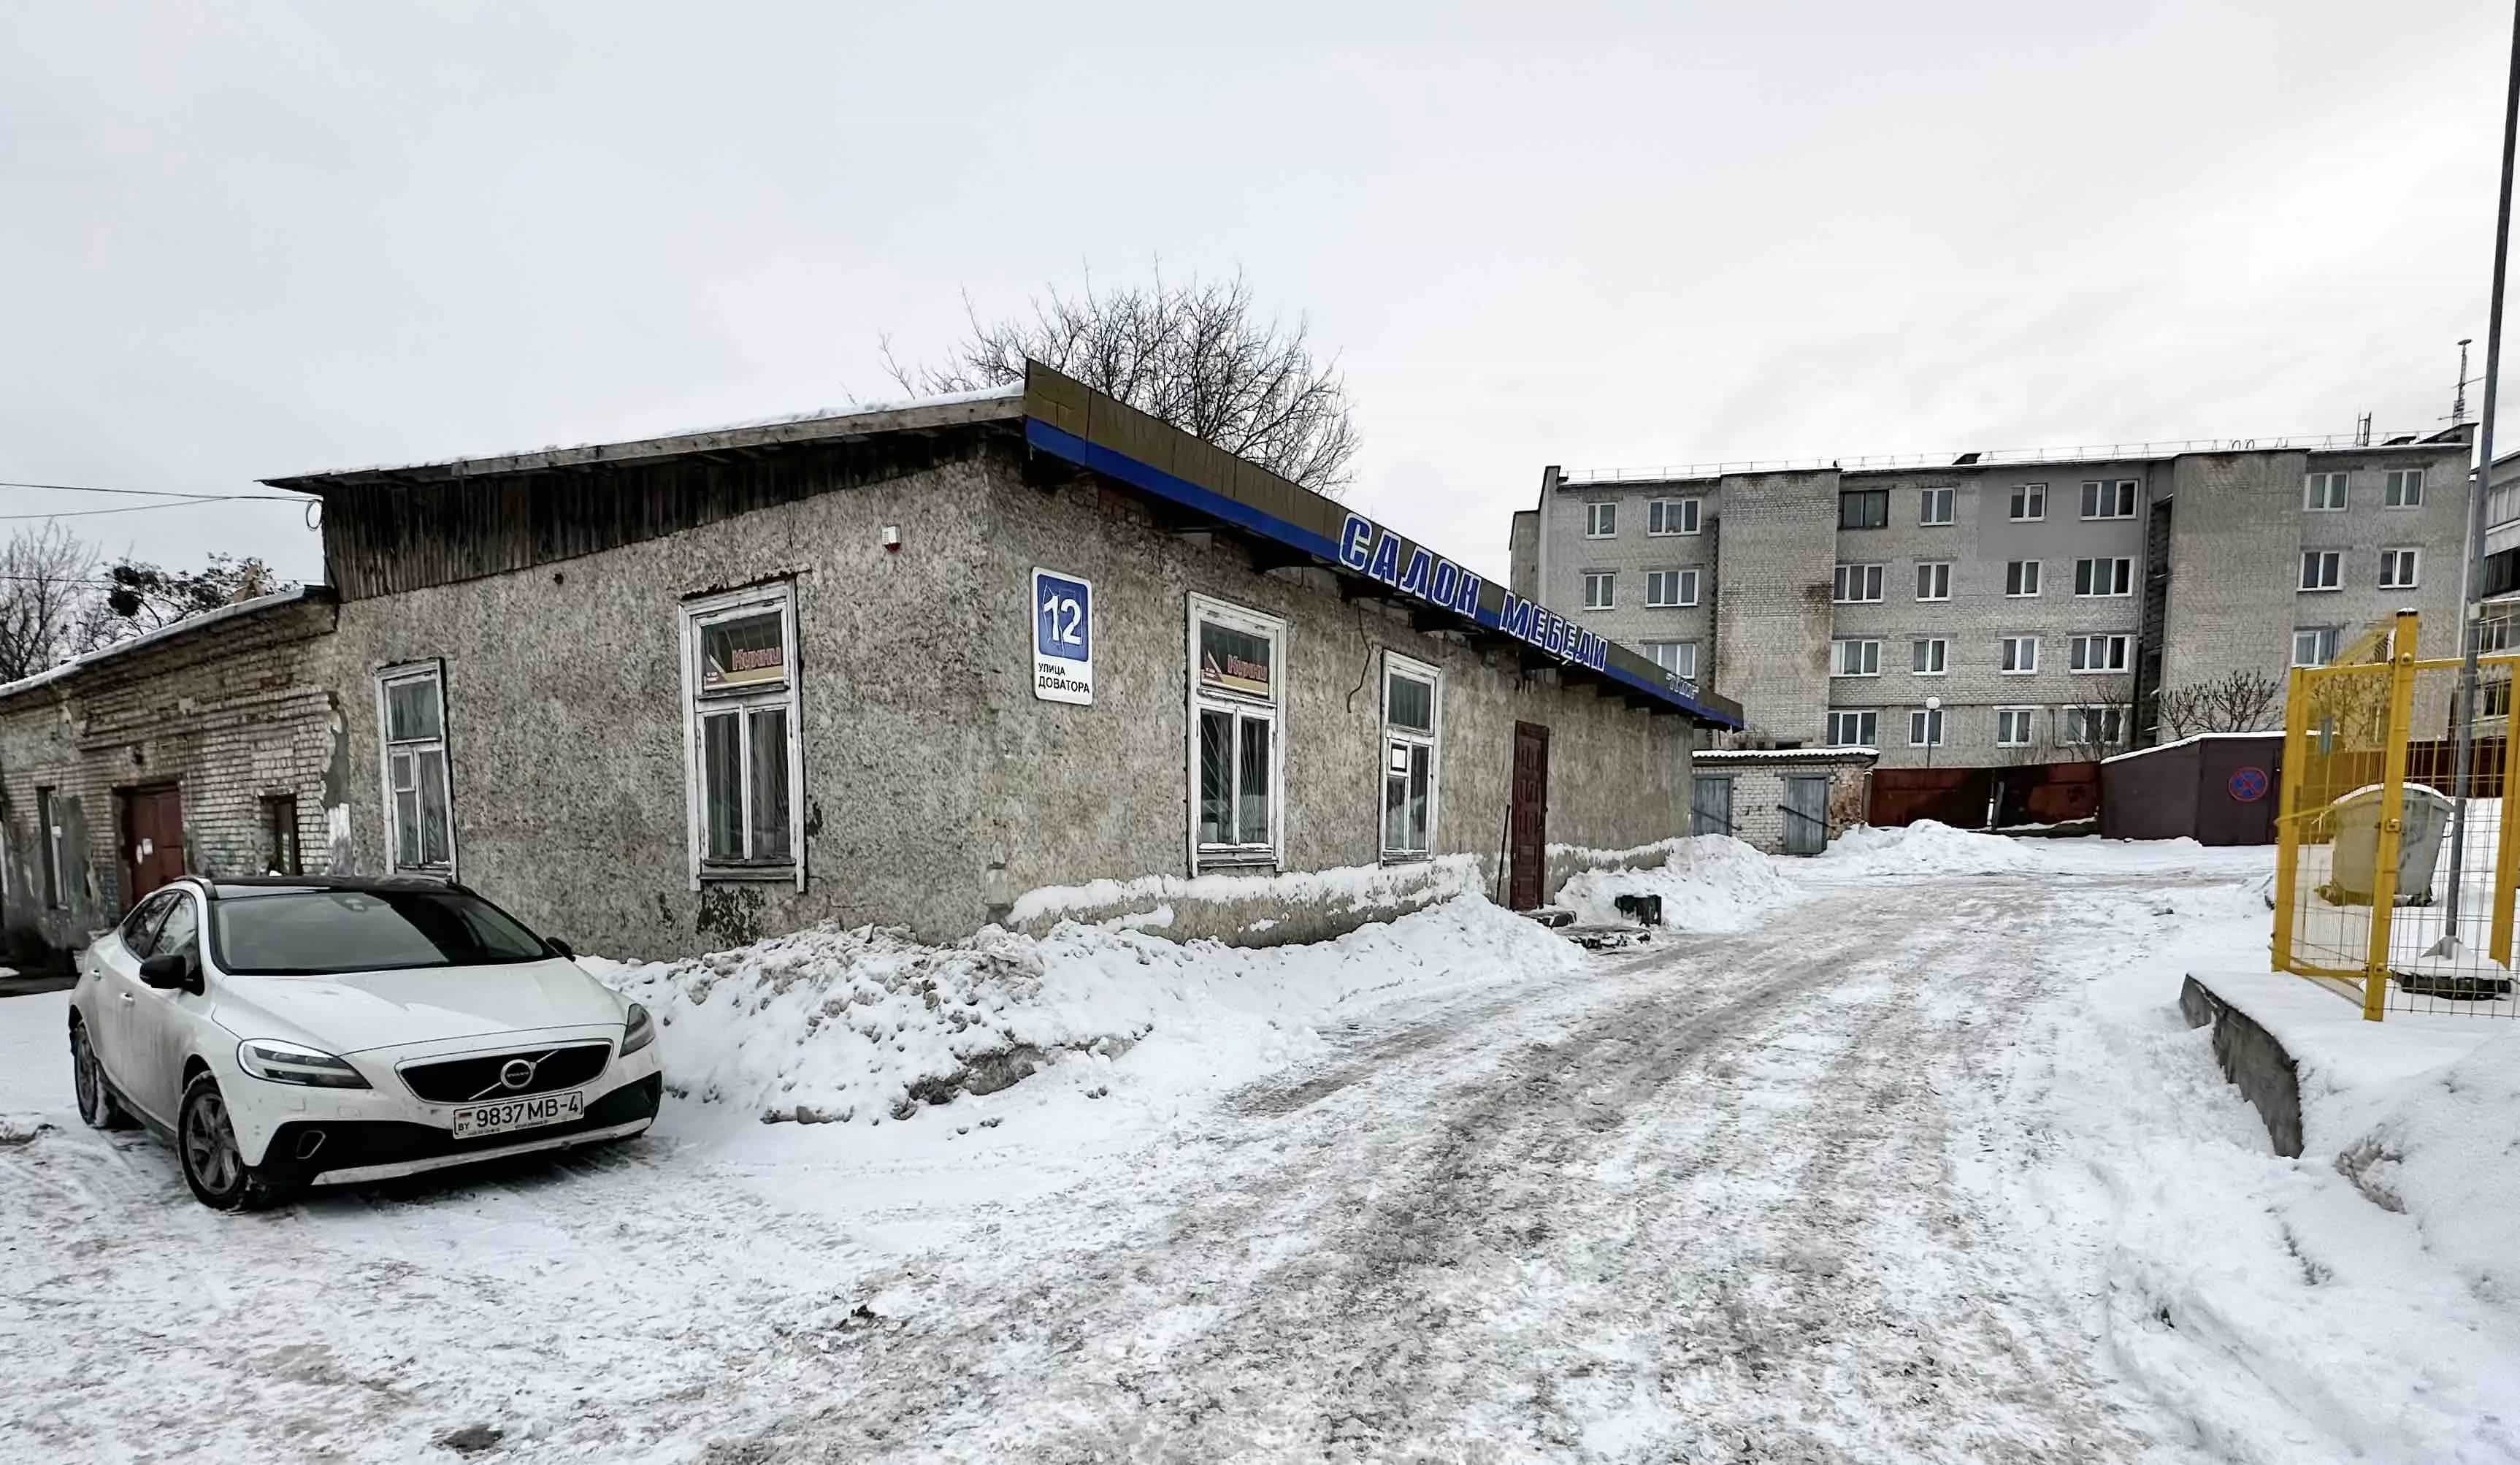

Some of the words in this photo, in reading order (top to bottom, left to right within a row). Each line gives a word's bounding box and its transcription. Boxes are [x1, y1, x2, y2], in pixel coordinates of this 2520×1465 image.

[1337, 510, 1482, 619] САЛОН
[1498, 590, 1609, 672] МЕБЕЛИ
[1043, 595, 1081, 646] 12
[1038, 662, 1065, 676] УЛИЦА
[1038, 676, 1090, 693] ДОВАТОРА
[457, 1122, 470, 1131] BY
